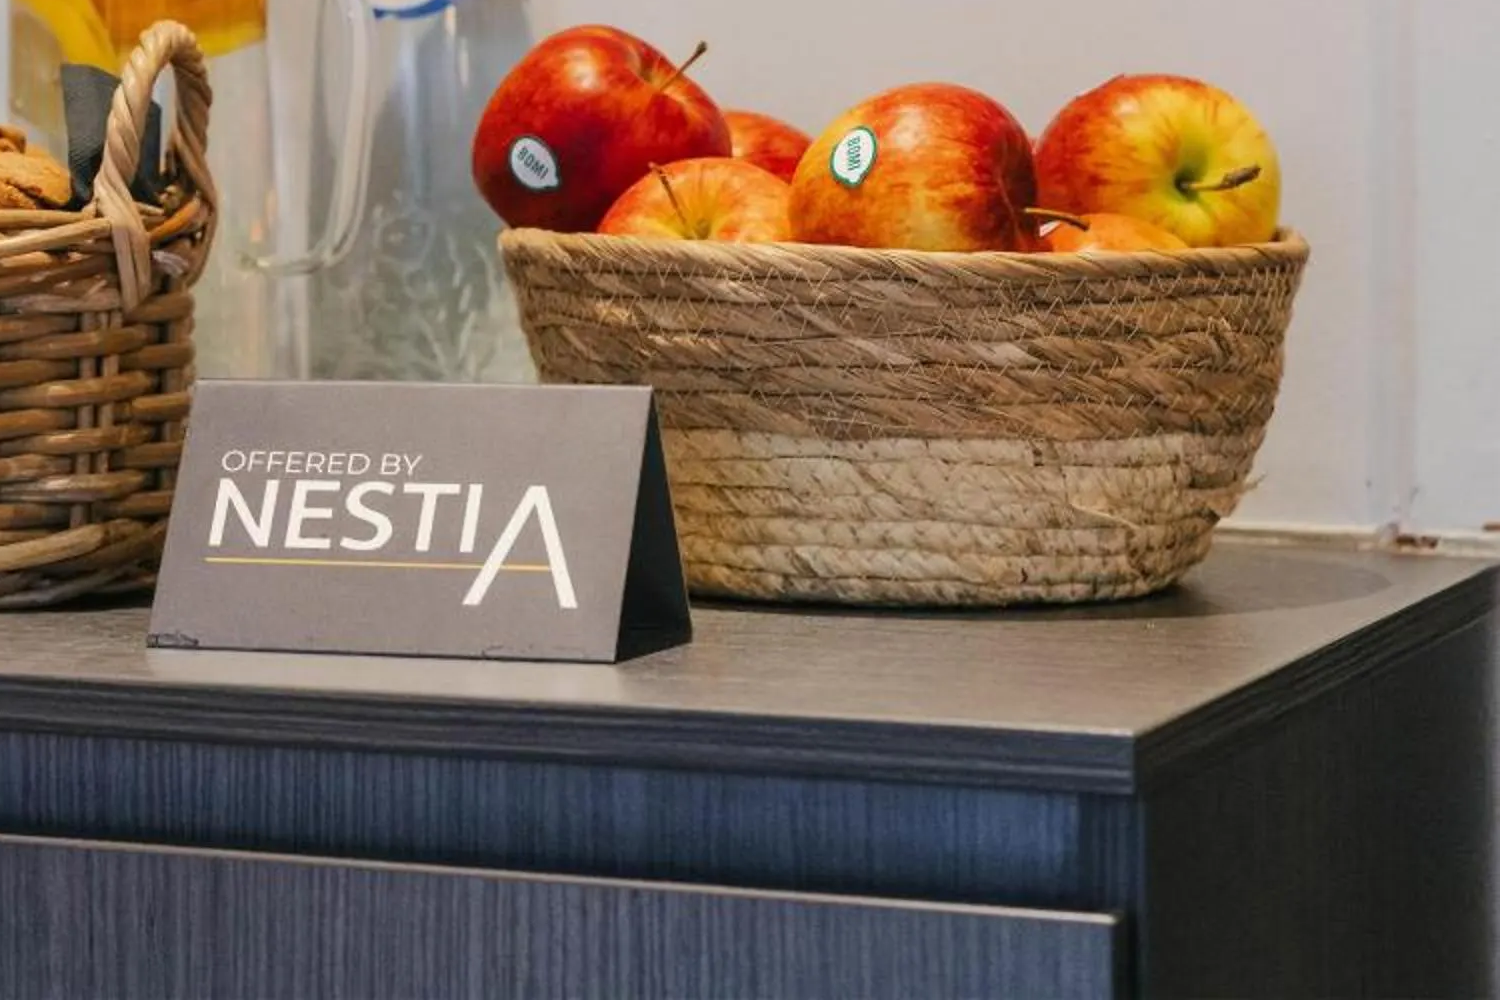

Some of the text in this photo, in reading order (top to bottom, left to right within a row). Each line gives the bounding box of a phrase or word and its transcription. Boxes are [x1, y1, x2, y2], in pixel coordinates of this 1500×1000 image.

[517, 146, 549, 180] BOMI
[221, 450, 423, 477] OFFERED BY
[208, 479, 578, 609] NESTIA
